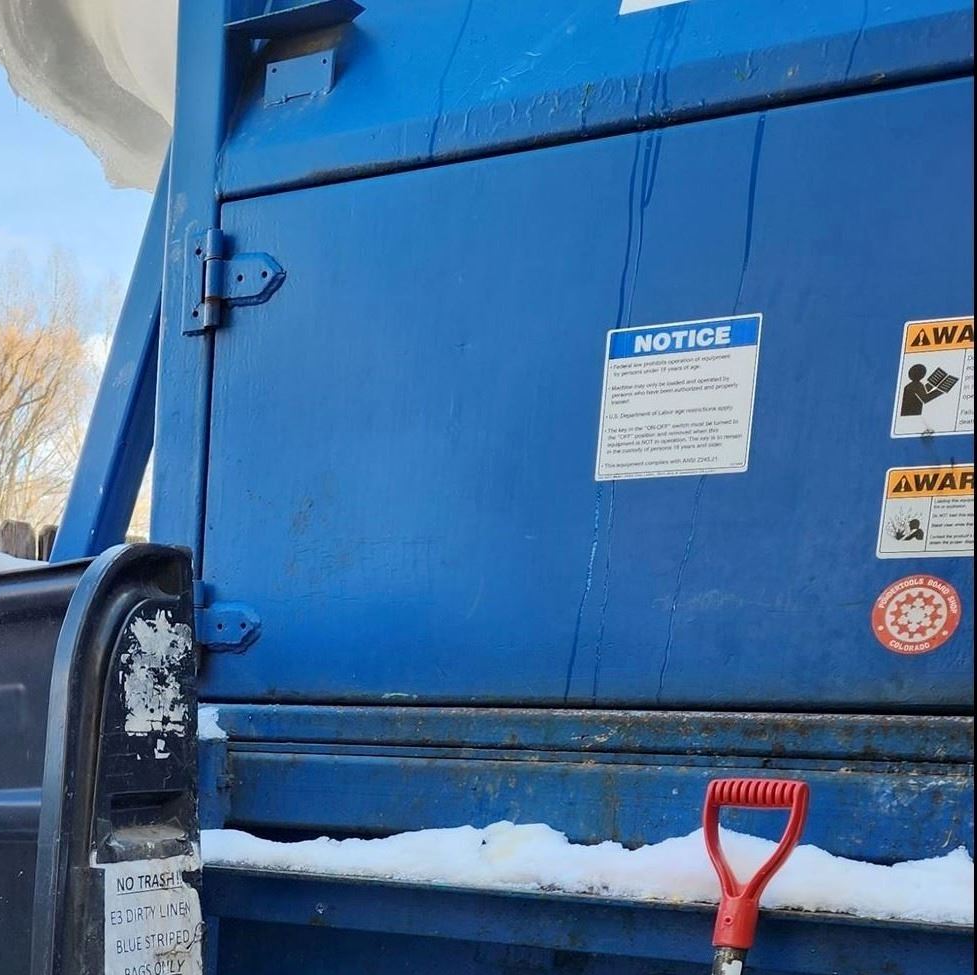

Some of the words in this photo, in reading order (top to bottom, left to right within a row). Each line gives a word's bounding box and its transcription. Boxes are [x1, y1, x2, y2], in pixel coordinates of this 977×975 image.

[633, 325, 732, 354] NOTICE
[643, 358, 667, 368] prohibits
[668, 357, 694, 365] operation
[702, 354, 731, 362] equipment
[621, 369, 643, 377] persons
[668, 366, 682, 374] years
[611, 391, 632, 399] persons
[716, 382, 738, 391] properly
[620, 410, 651, 419] Department
[622, 446, 642, 454] custody
[650, 445, 672, 453] persons
[616, 461, 644, 469] equipment
[927, 578, 950, 595] BOARD
[947, 595, 958, 614] SHOP
[889, 639, 930, 652] COLORADO
[116, 876, 134, 892] NO
[110, 910, 123, 926] E3
[126, 905, 156, 924] DIRTY
[159, 901, 191, 919] LINEN
[116, 937, 142, 954] BLUE
[145, 929, 190, 949] STRIPED
